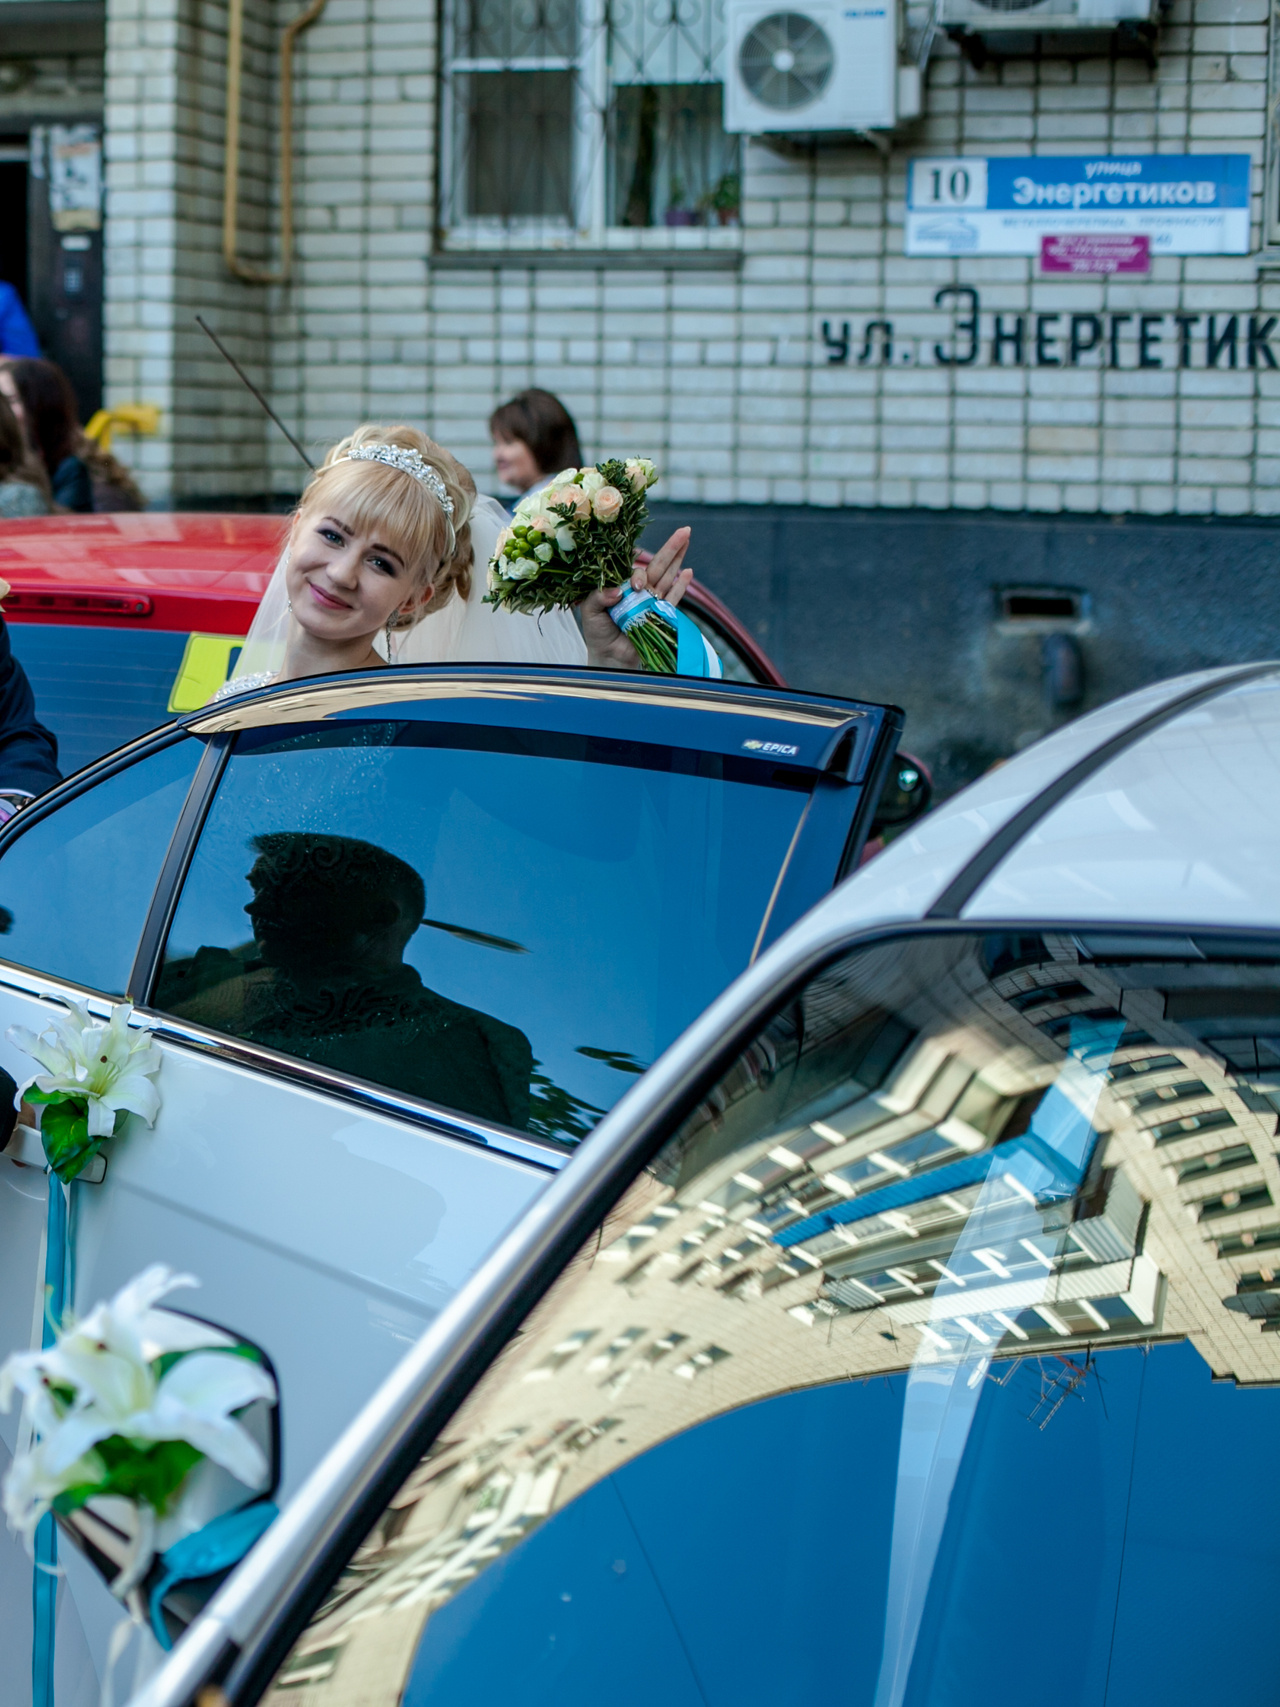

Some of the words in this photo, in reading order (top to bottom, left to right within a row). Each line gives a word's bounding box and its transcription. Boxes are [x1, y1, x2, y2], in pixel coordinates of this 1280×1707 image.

[1084, 161, 1142, 180] улица
[930, 167, 970, 203] 10
[1013, 176, 1216, 210] Энергетиков
[763, 742, 798, 755] EPICA
